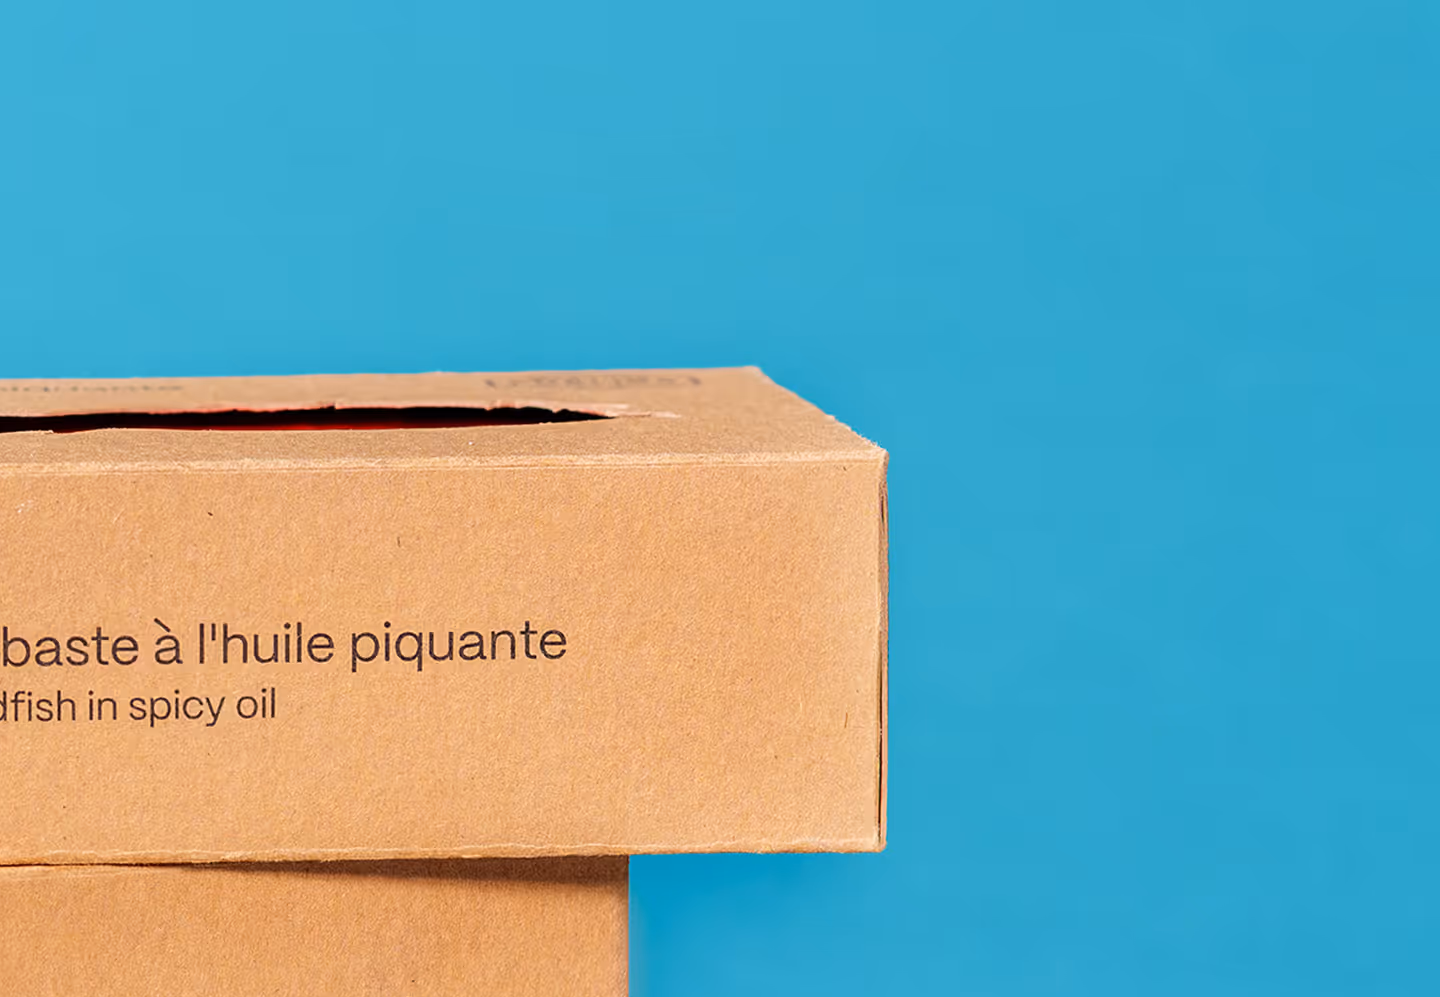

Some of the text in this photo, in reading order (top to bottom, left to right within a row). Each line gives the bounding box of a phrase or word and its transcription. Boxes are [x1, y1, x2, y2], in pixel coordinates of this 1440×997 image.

[154, 617, 183, 665] à
[200, 622, 335, 664] l'huile
[352, 620, 567, 673] piquante
[89, 689, 118, 721] in
[130, 688, 225, 728] spicy
[237, 686, 276, 720] oil
